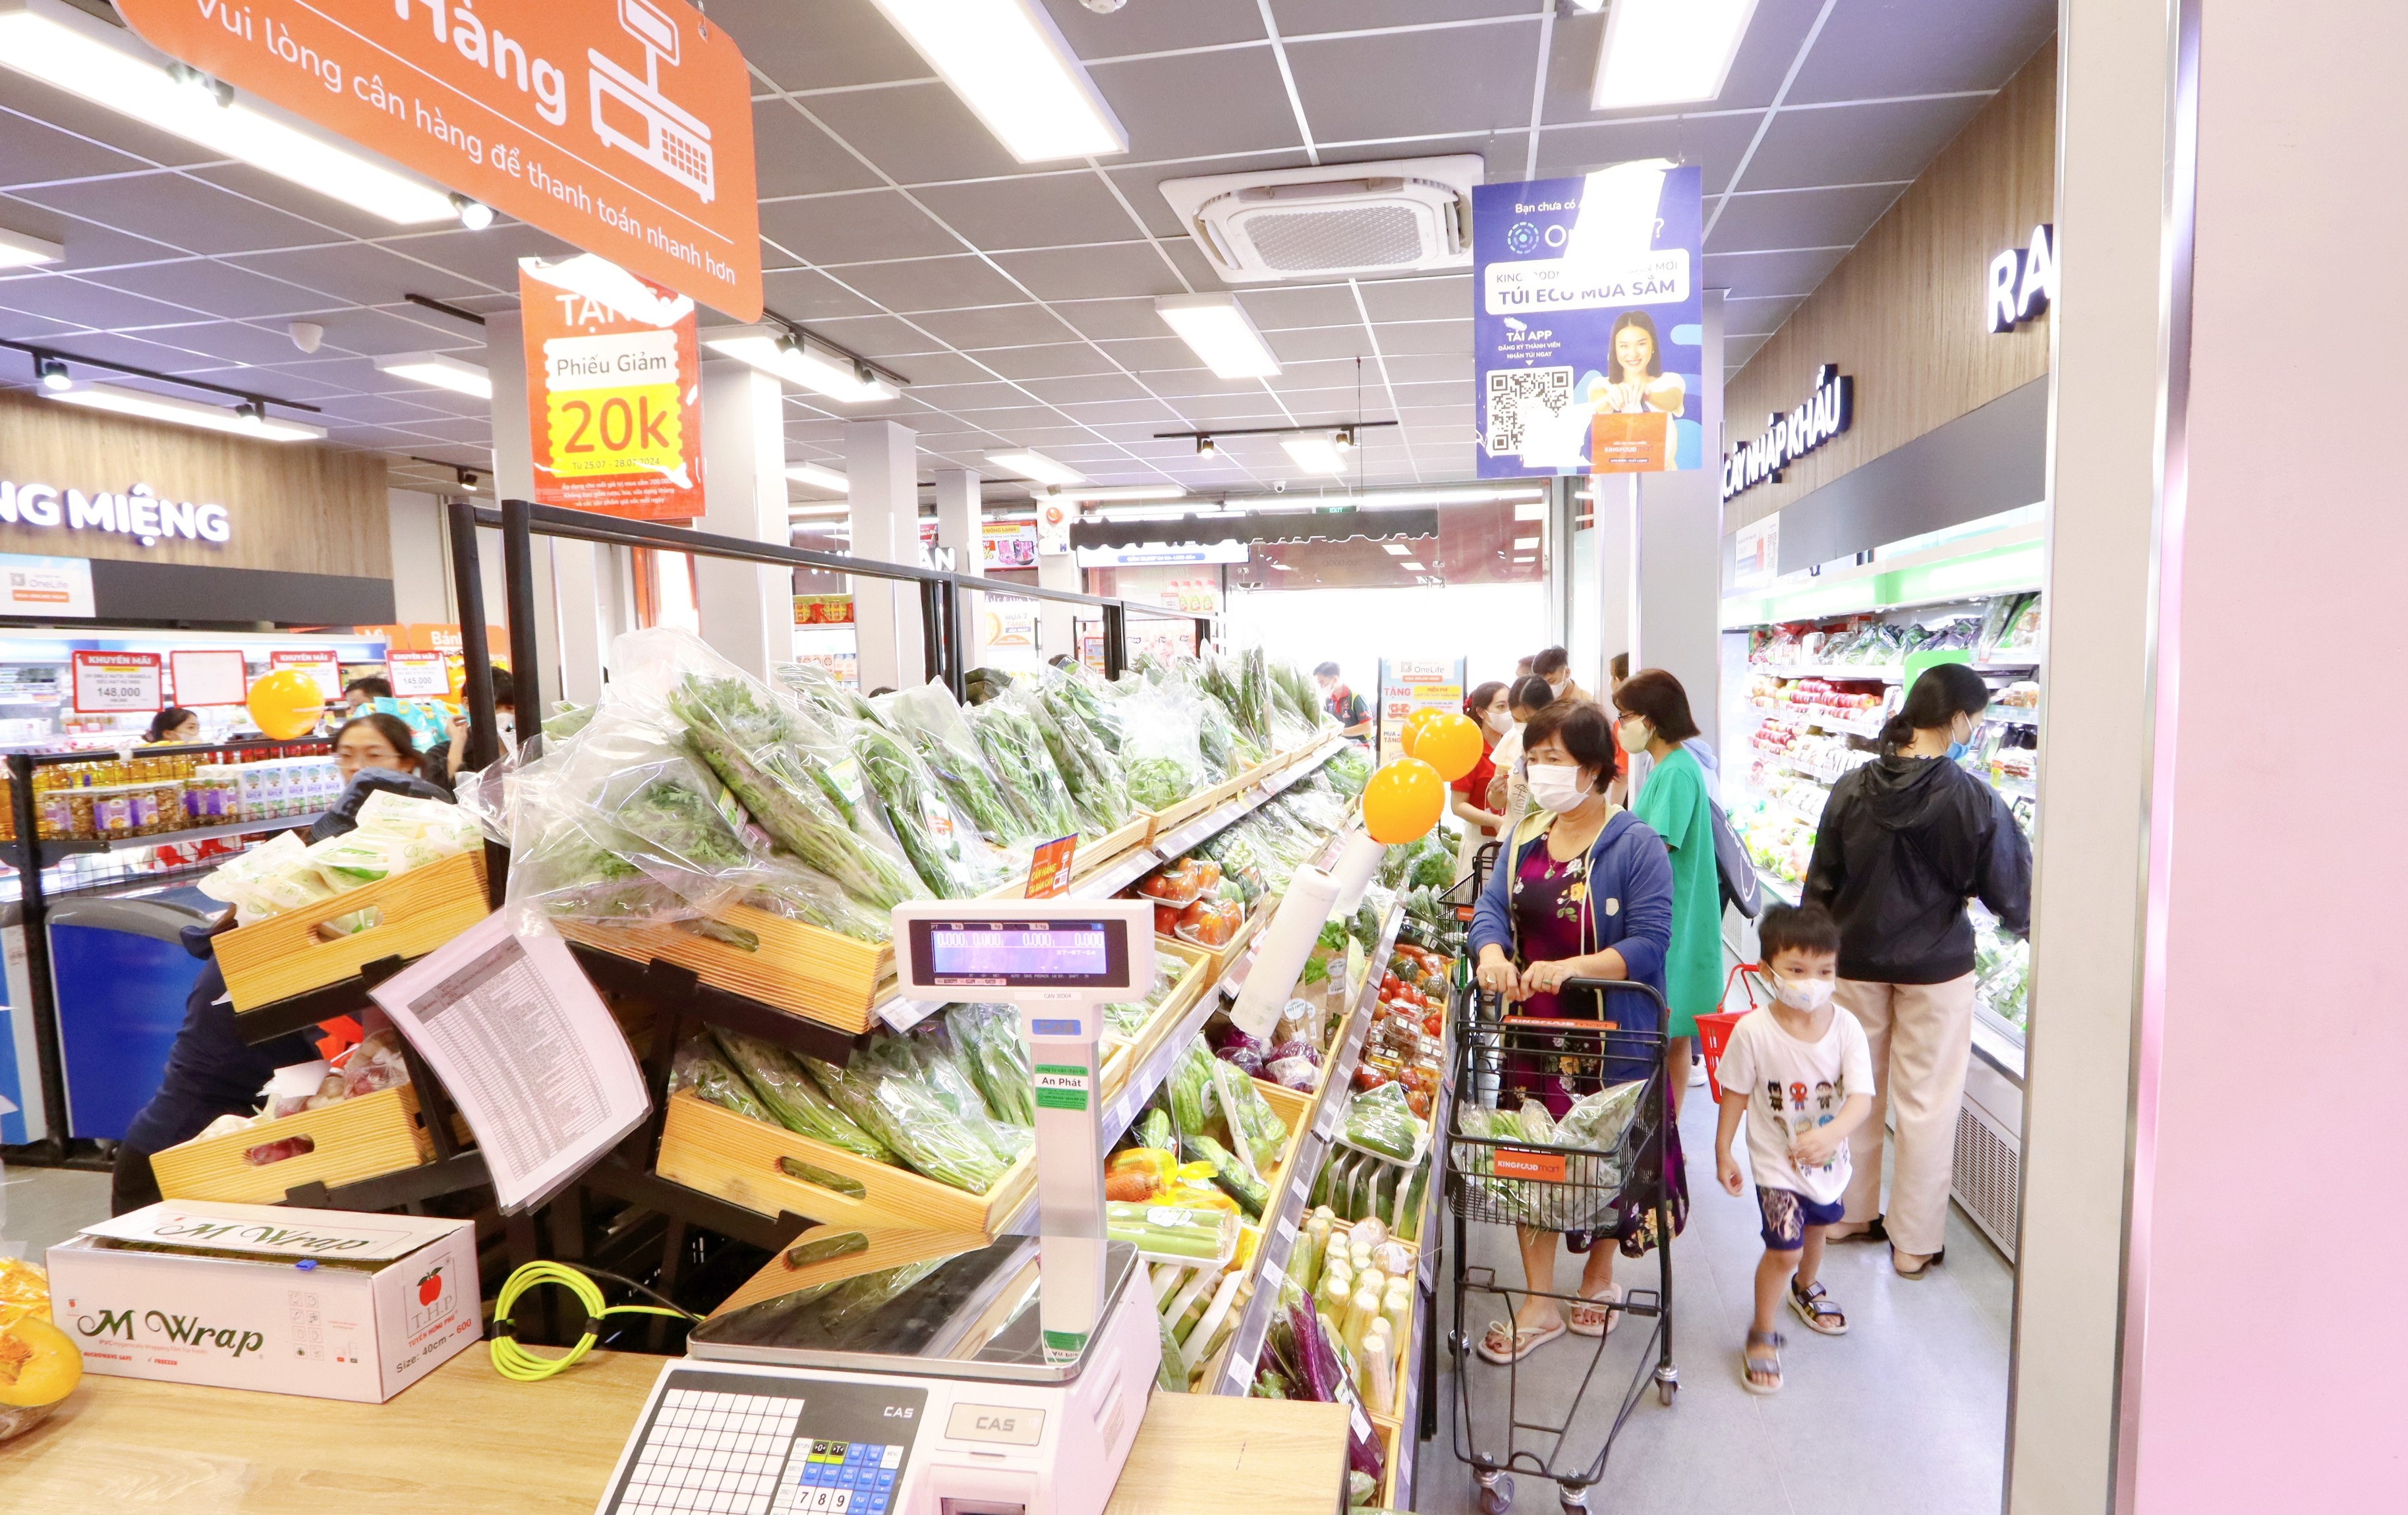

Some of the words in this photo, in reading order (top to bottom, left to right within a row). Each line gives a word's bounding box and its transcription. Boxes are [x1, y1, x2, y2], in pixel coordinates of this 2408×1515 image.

[265, 17, 342, 93] lòng
[353, 74, 406, 120] cân
[415, 98, 482, 164] hàng
[490, 144, 521, 178] để
[527, 163, 592, 215] thanh
[596, 198, 641, 241] toán
[647, 227, 701, 268] nhanh
[706, 259, 735, 286] hơn
[1516, 202, 1535, 215] Bạn
[1537, 202, 1562, 212] chưa
[1564, 198, 1576, 210] có
[1499, 286, 1530, 305] TÚI
[1582, 283, 1626, 300] MUA
[1632, 275, 1675, 296] SẮM
[1528, 330, 1552, 341] APP
[557, 352, 610, 376] Phiếu
[617, 352, 667, 372] Giảm
[561, 395, 670, 454] 20k
[1746, 413, 1787, 484] NHẬP
[1787, 364, 1841, 461] KHẨU
[573, 461, 582, 470] Từ
[67, 484, 230, 546] MIỆNG
[88, 654, 130, 664] KHUYẾN
[132, 655, 152, 664] MÃI
[313, 652, 328, 661] MÃI
[393, 652, 420, 661] KHUYẾN
[1384, 686, 1411, 699] TẶNG
[1042, 1077, 1055, 1085] An
[1059, 1078, 1081, 1087] Phát
[1497, 1160, 1560, 1172] KINGFOODmart
[154, 1224, 244, 1240] M
[240, 1226, 370, 1252] Wrap
[412, 1295, 453, 1330] T.H.P
[77, 1310, 136, 1340] M
[145, 1310, 264, 1358] Wrap
[397, 1354, 420, 1373] Size:
[422, 1336, 447, 1356] 40cm
[457, 1318, 472, 1334] 600
[884, 1406, 914, 1418] CAS
[975, 1417, 1016, 1432] CAS
[799, 1492, 809, 1504] 7
[818, 1493, 826, 1506] 8
[836, 1495, 845, 1508] 9
